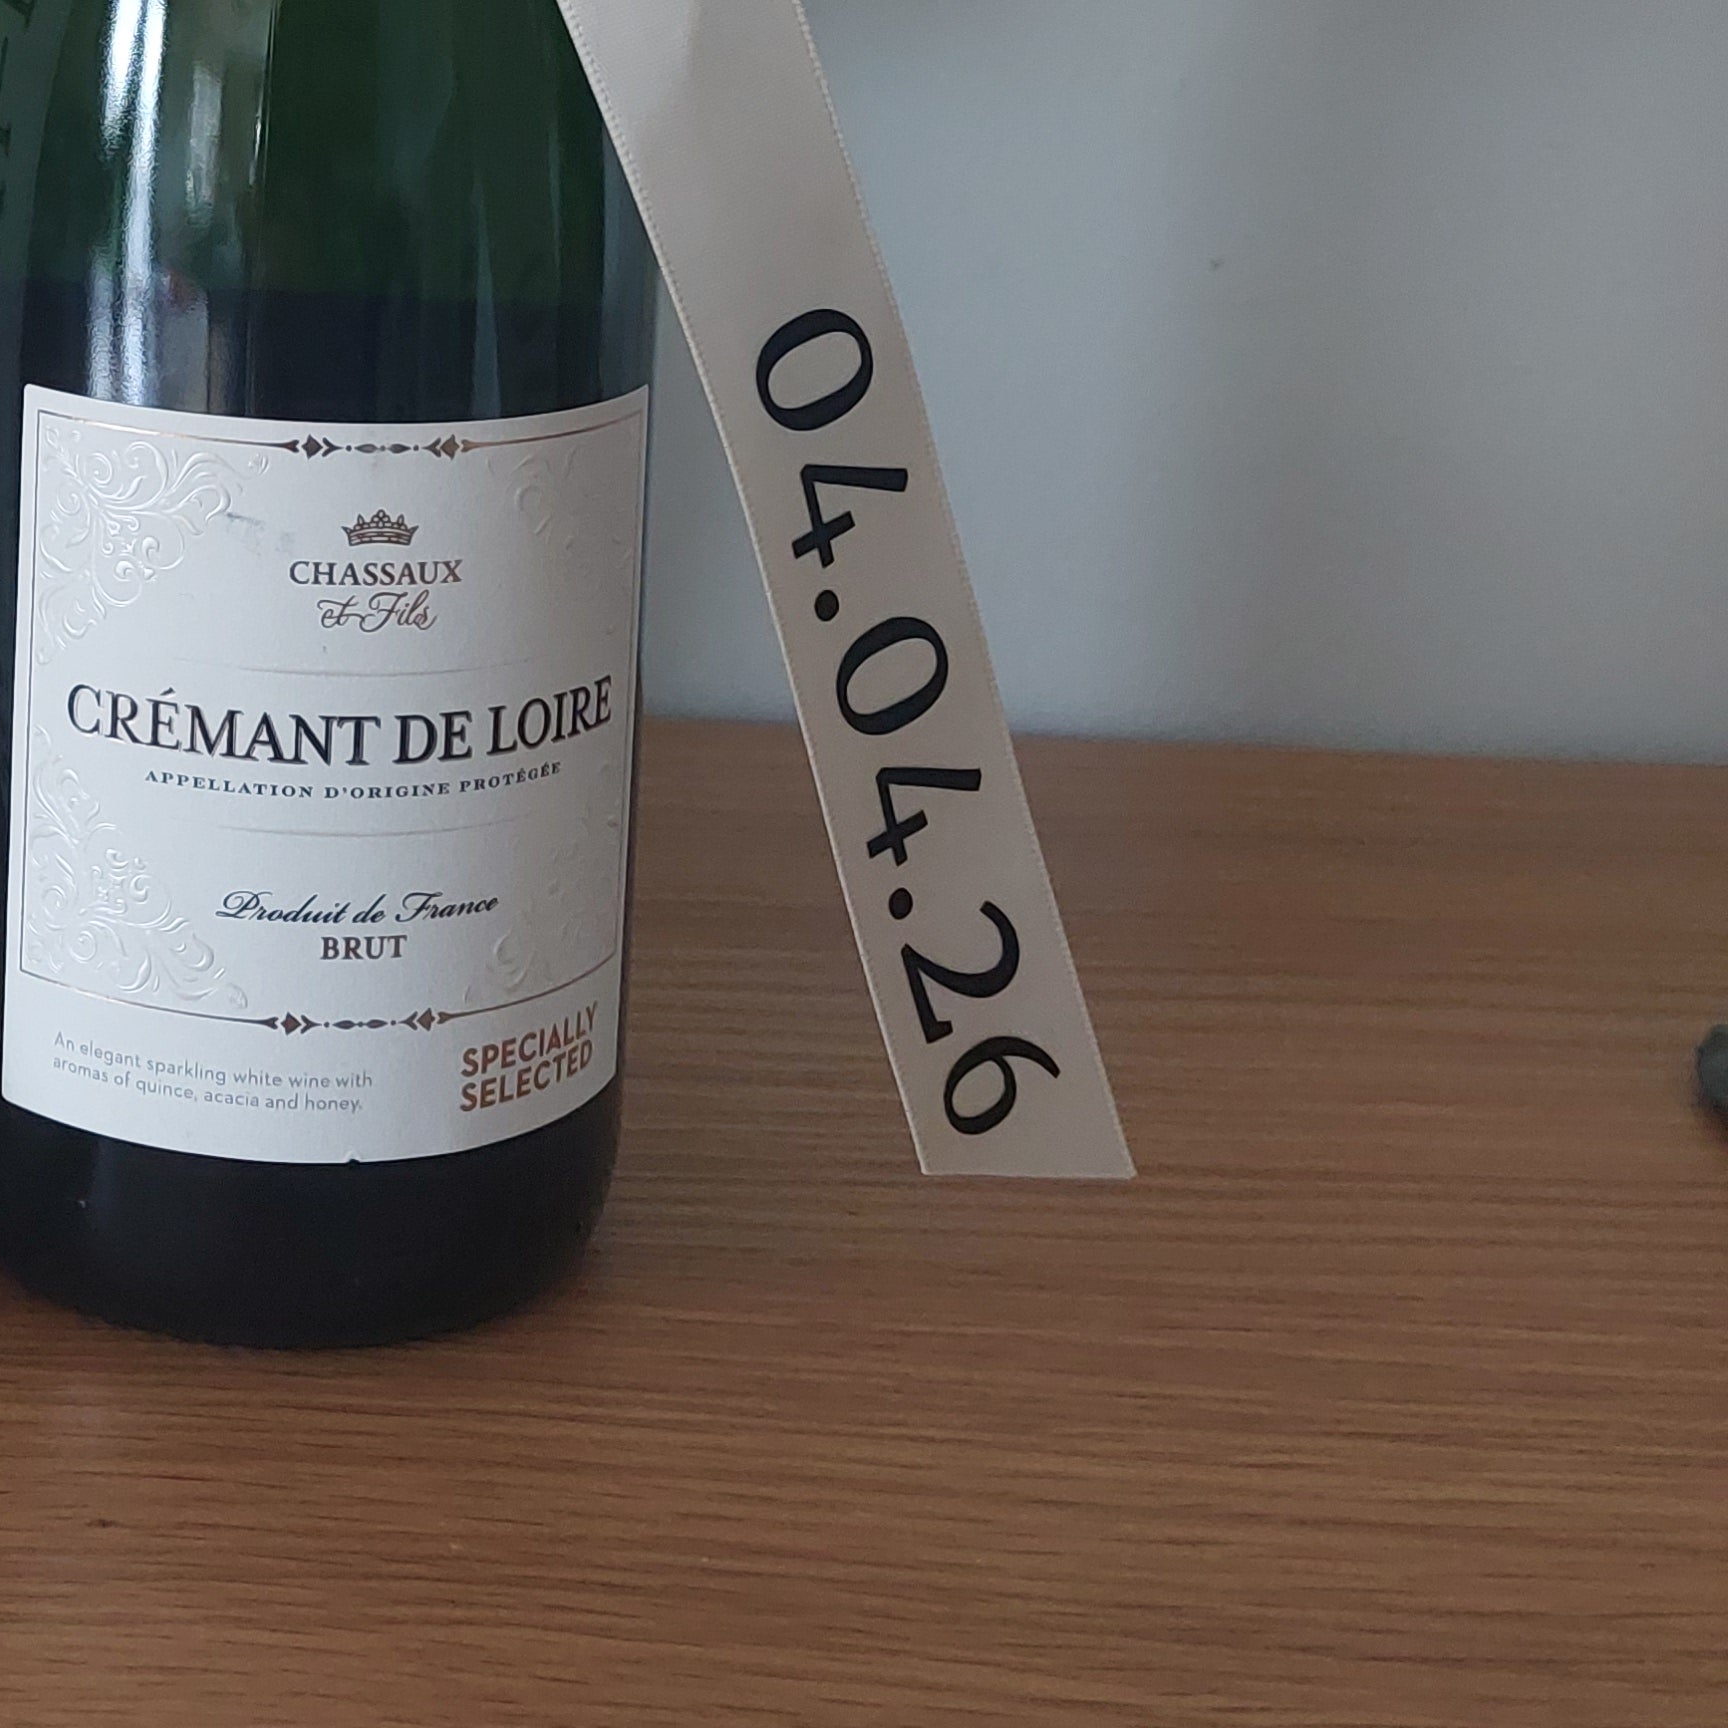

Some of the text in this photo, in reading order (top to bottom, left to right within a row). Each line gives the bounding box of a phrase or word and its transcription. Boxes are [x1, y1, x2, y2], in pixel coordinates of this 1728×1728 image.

[288, 558, 464, 587] CHASSAUX
[316, 588, 439, 633] et Fils
[67, 674, 613, 766] CRÉMANT DE LOIRE
[755, 307, 1061, 1136] 04.04.26
[144, 761, 562, 800] APPELLATION D'ORIGINE PROTÉGÉE
[215, 889, 501, 925] Produit de France
[319, 934, 408, 961] BRUT
[53, 1030, 373, 1089] An elegant sparkling white wine with
[460, 1000, 598, 1078] SPECIALLY
[52, 1054, 364, 1113] aromas of quince, acacia and honey.
[459, 1038, 593, 1113] SELECTED
